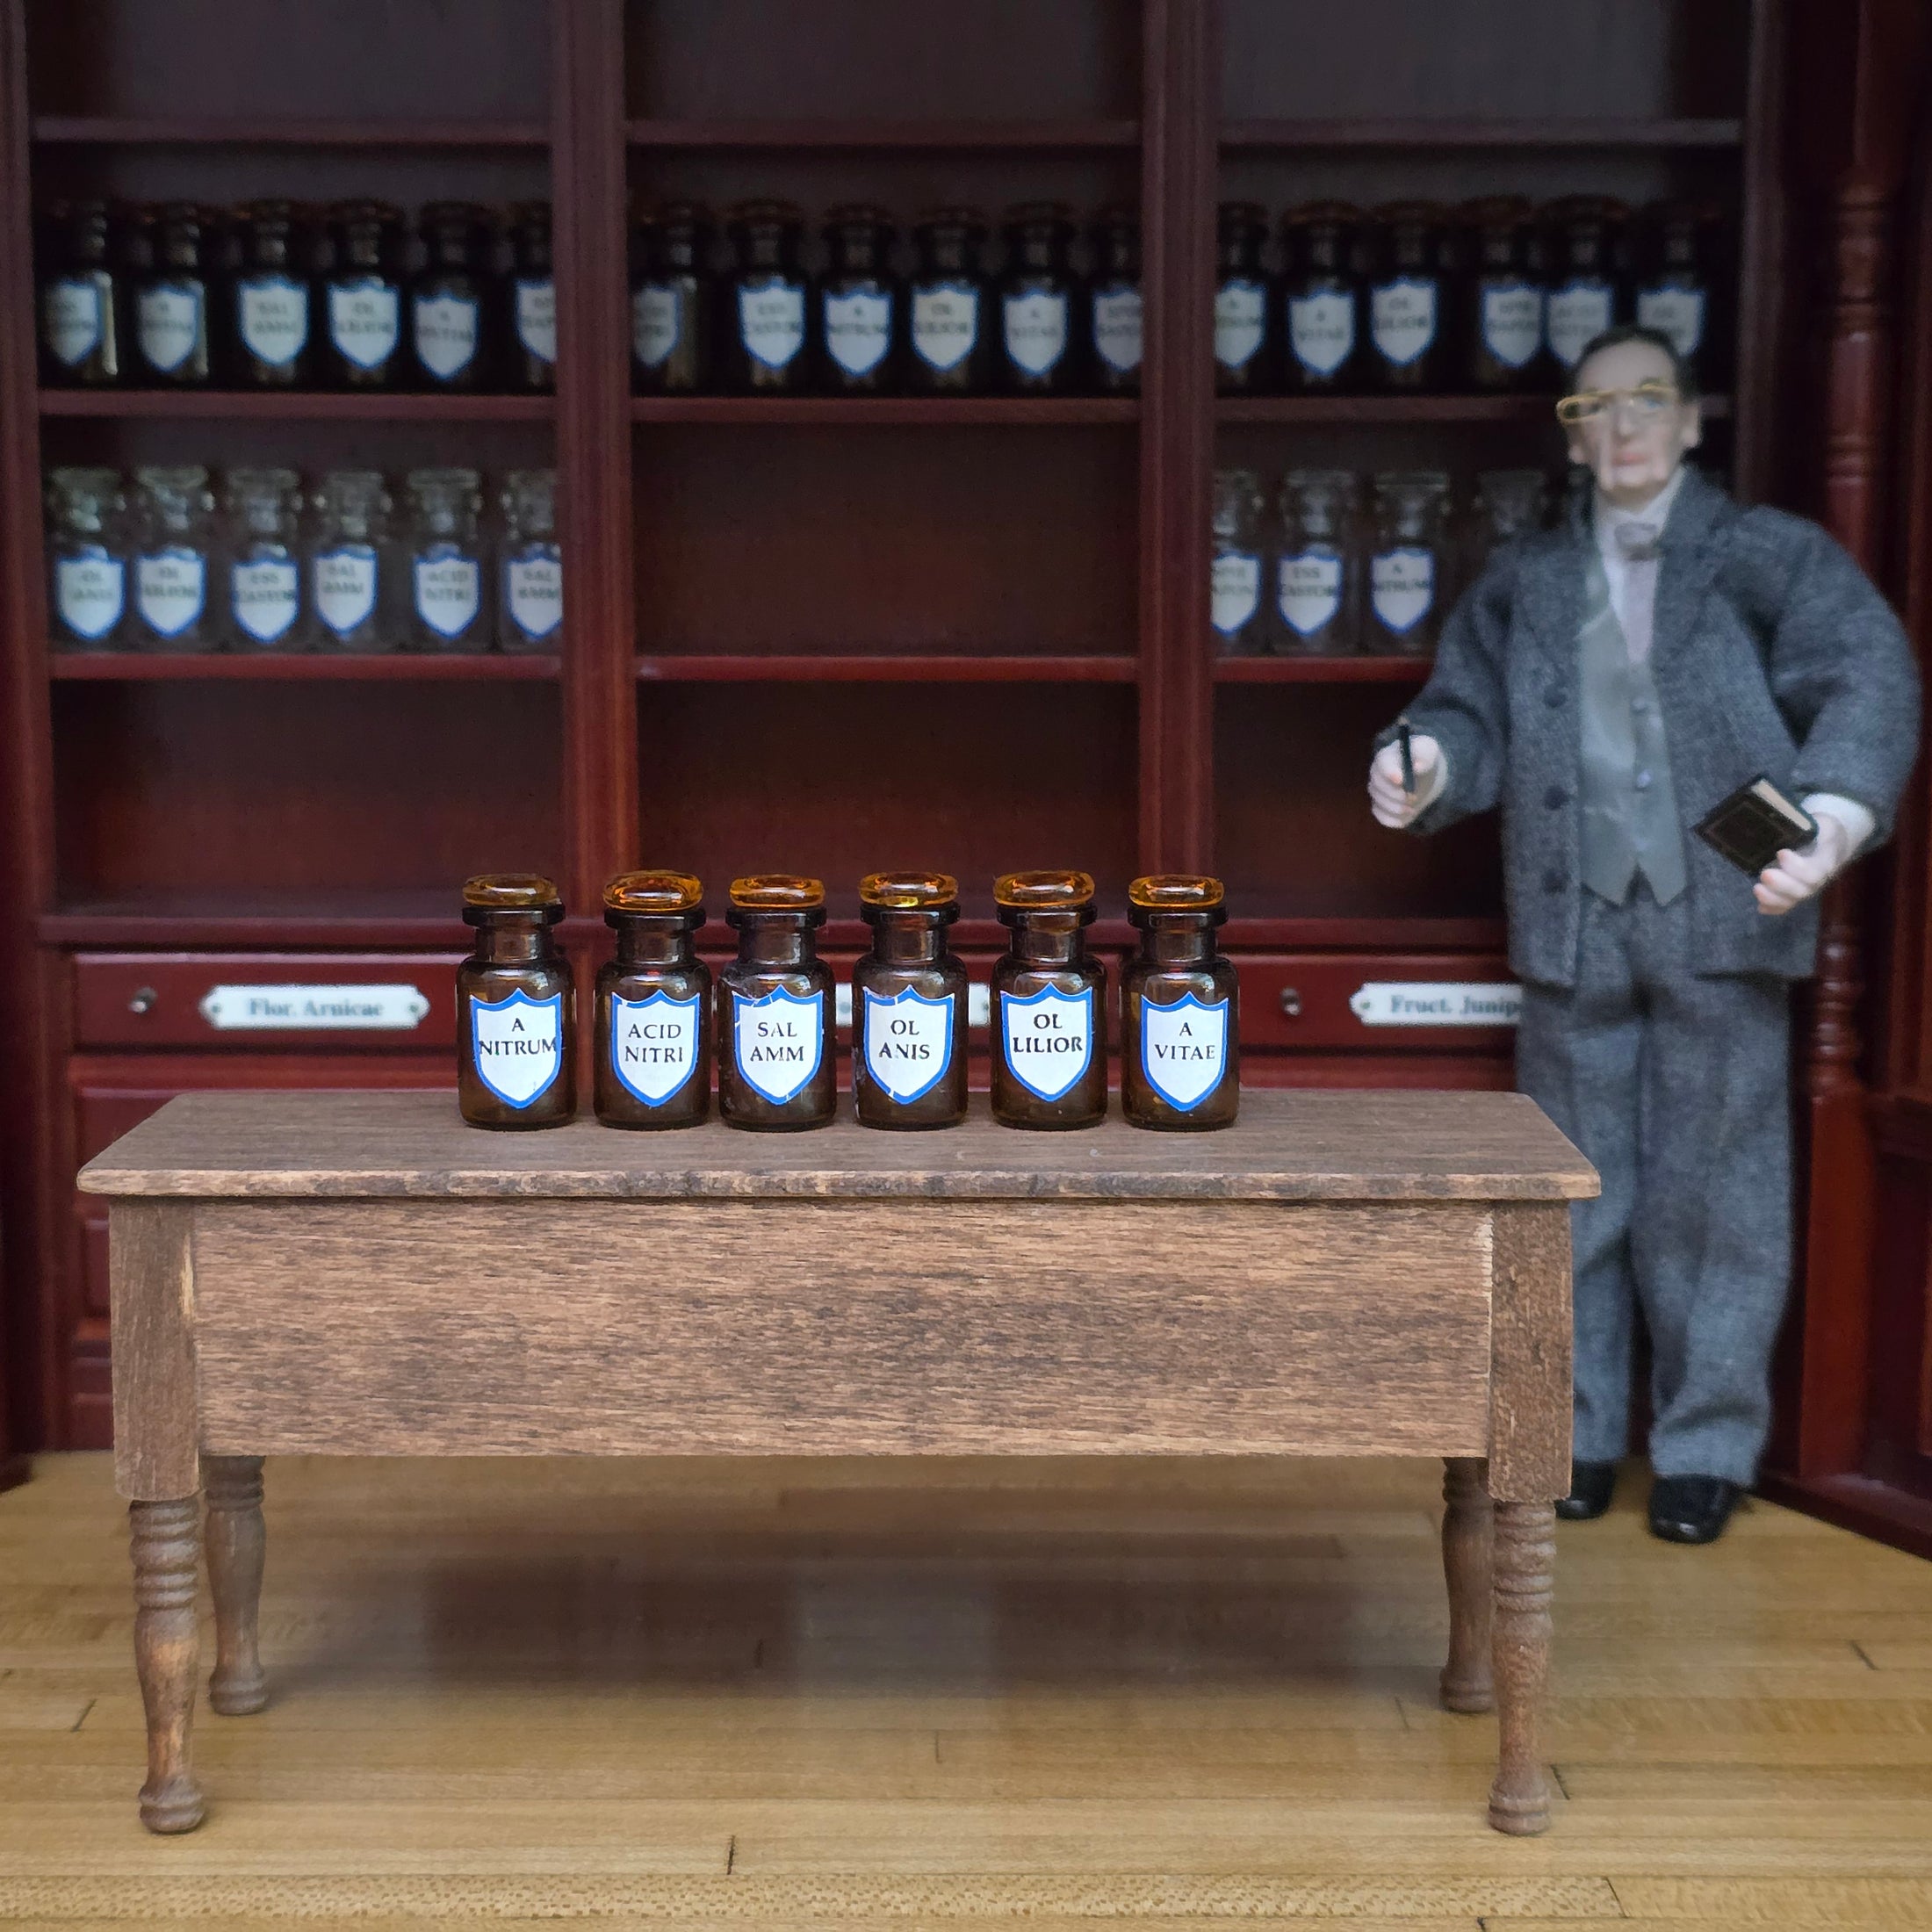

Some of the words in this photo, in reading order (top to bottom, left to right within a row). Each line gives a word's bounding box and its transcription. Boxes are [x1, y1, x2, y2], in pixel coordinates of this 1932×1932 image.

[511, 1018, 525, 1032] A
[757, 1021, 797, 1037] SAL
[890, 1020, 919, 1035] OL
[1033, 1013, 1063, 1029] OL
[1179, 1021, 1193, 1036] A
[628, 1023, 681, 1040] ACID
[478, 1039, 558, 1056] NITRUM
[878, 1042, 930, 1060] ANIS
[1013, 1035, 1083, 1054] LILIOR
[1154, 1044, 1215, 1060] VITAE
[625, 1045, 683, 1063] NITRI
[750, 1046, 804, 1062] AMM
